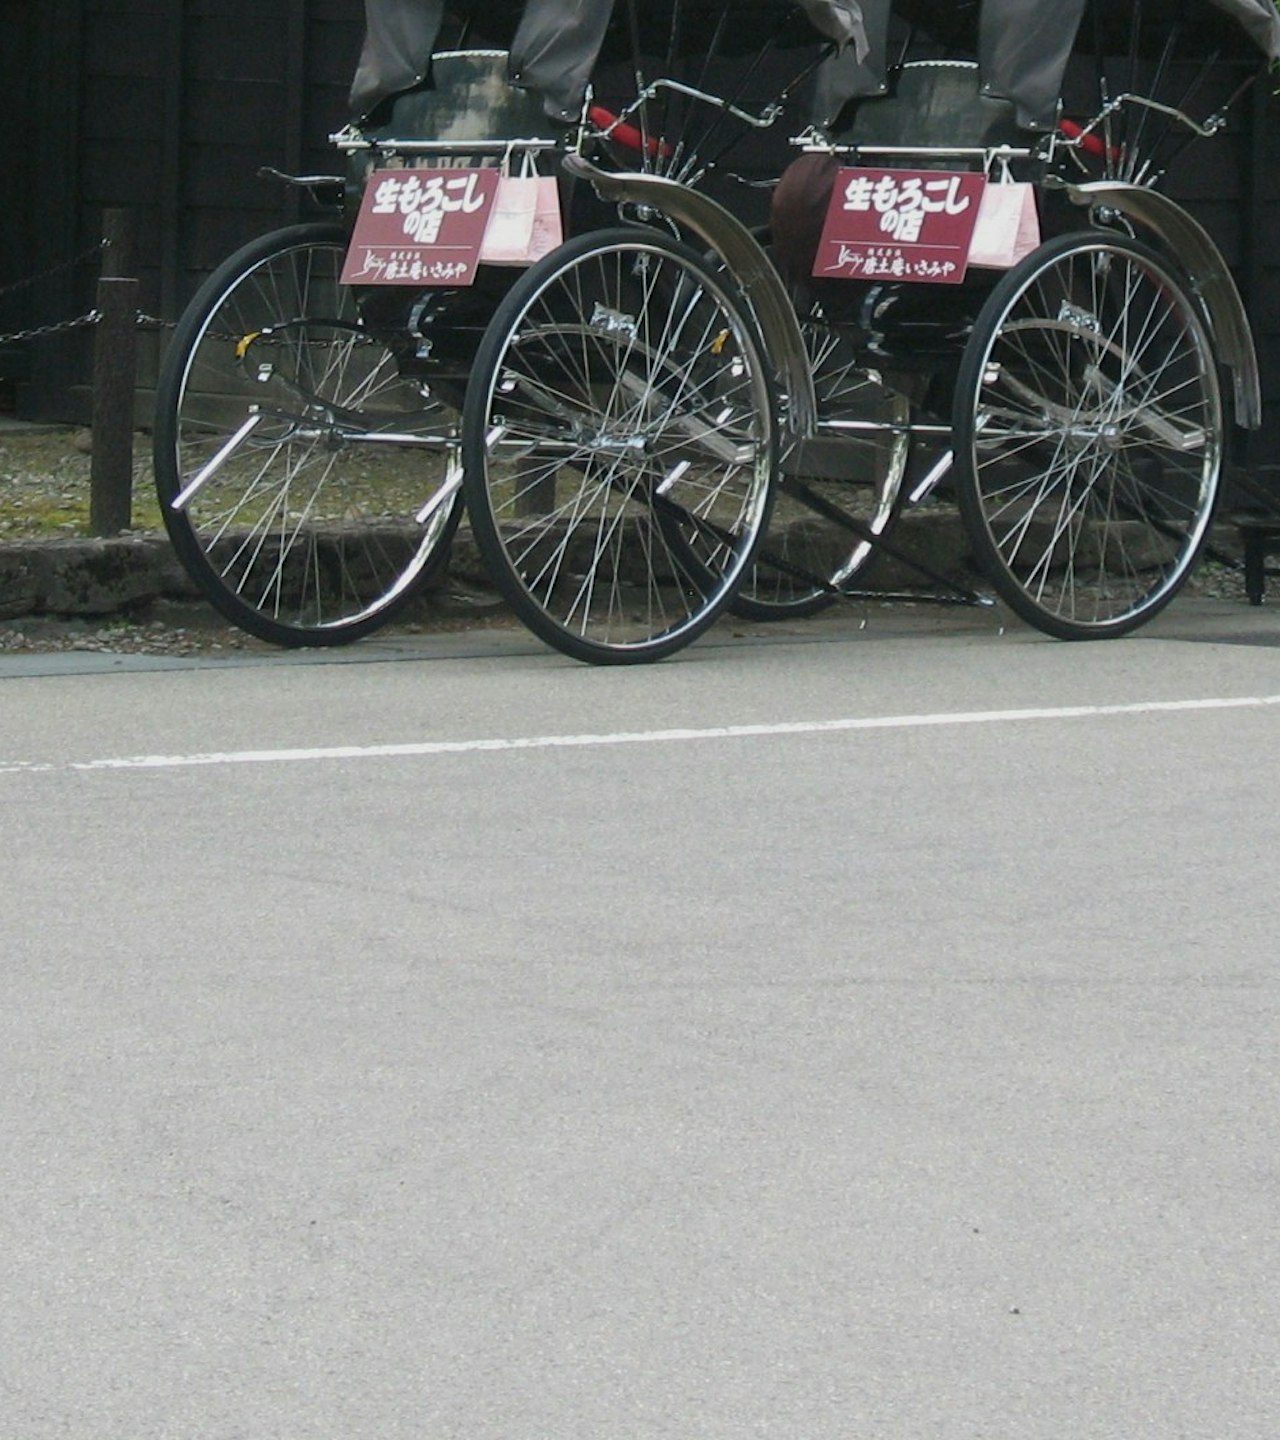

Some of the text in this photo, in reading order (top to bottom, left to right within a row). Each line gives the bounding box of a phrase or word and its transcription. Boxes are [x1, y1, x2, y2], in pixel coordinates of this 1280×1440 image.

[372, 173, 484, 213] 生もろこし
[843, 176, 970, 214] 生もろこし
[403, 211, 444, 243] の店
[880, 211, 925, 242] の店
